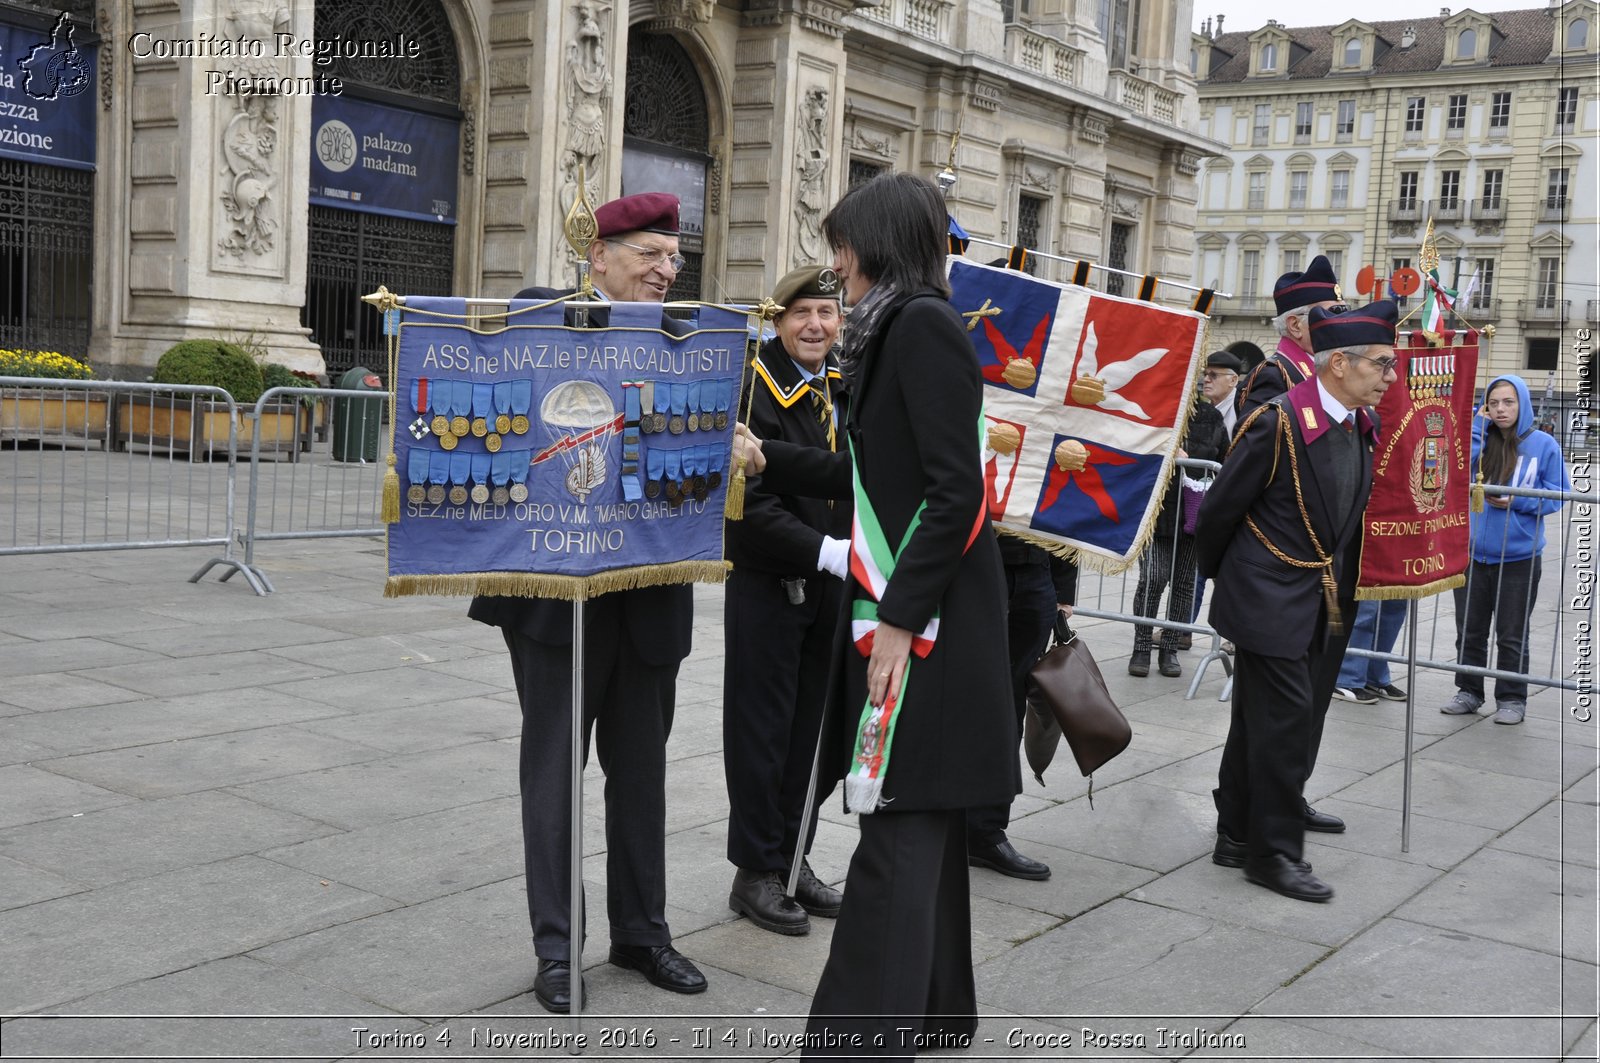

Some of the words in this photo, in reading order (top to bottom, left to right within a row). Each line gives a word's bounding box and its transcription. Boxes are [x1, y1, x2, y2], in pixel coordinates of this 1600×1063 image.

[362, 132, 412, 155] palazzo
[362, 155, 417, 176] madama
[422, 343, 499, 375] ASS.ne
[504, 344, 571, 372] NAZ.le
[575, 346, 731, 375] PARACADUTISTI
[1376, 407, 1415, 477] Associazione
[1413, 396, 1446, 412] Nazionale
[1454, 437, 1465, 470] Stato
[407, 501, 465, 520] SEZ.ne
[469, 503, 510, 521] MED.
[514, 502, 555, 522] ORO
[558, 504, 590, 524] V.M.
[1370, 521, 1422, 536] SEZIONE
[524, 529, 624, 554] TORINO
